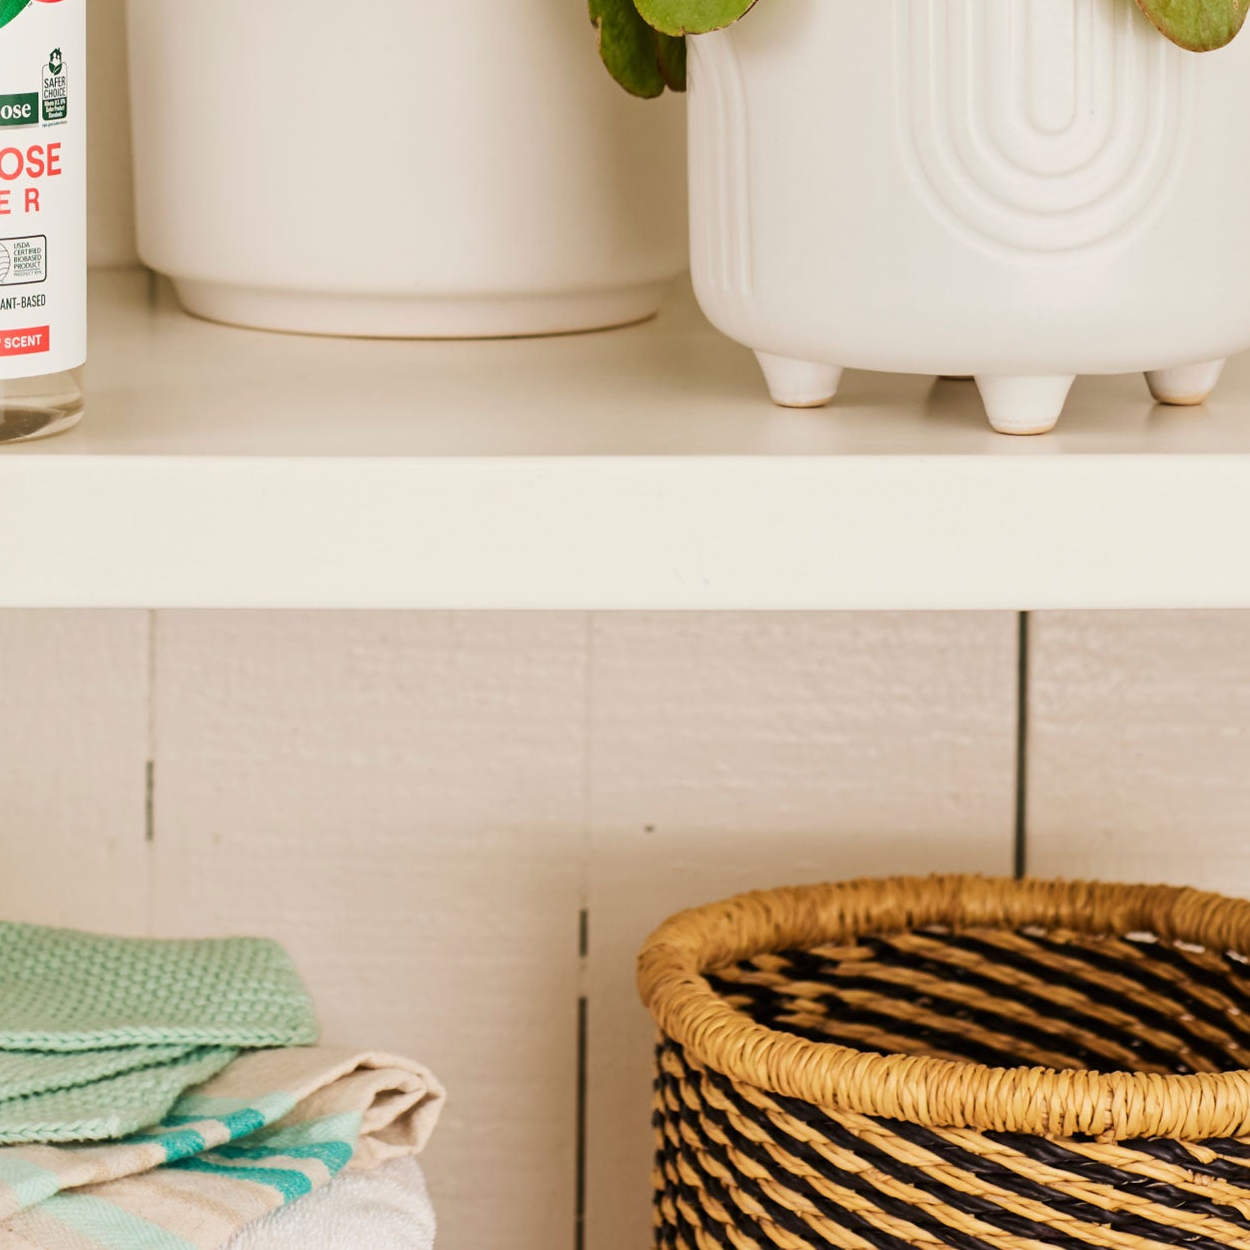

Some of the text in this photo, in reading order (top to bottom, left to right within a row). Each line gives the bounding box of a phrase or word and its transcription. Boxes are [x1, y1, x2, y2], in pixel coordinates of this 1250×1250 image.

[44, 76, 66, 89] SAFER
[43, 87, 66, 99] CHOICE
[3, 333, 43, 349] SCENT
